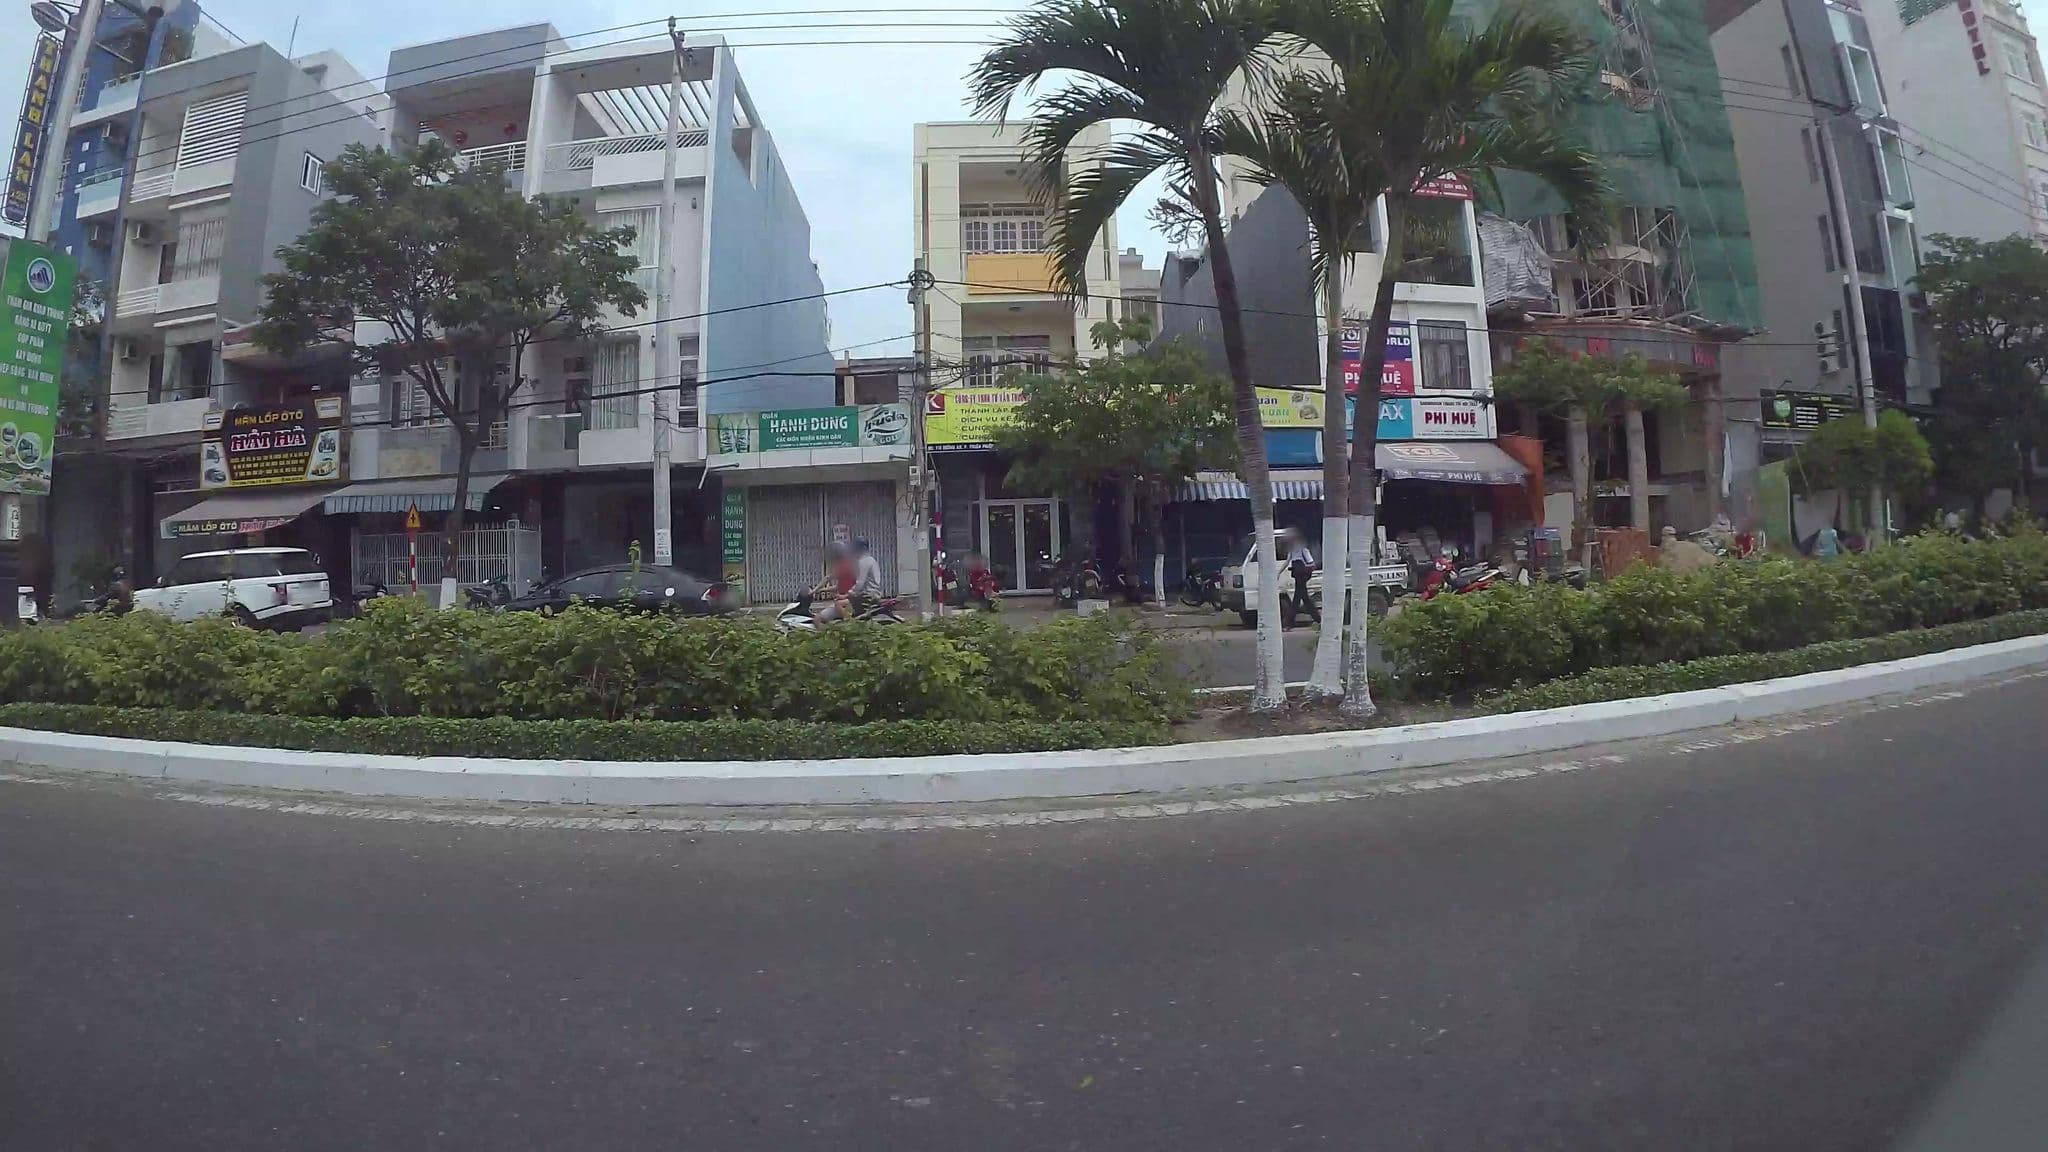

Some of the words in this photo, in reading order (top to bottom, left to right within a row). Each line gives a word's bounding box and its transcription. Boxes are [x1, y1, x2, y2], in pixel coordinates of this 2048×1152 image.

[1386, 337, 1410, 345] RLD
[770, 418, 808, 436] HẠNH
[1425, 412, 1447, 425] PHI
[1451, 409, 1477, 428] HUỆ
